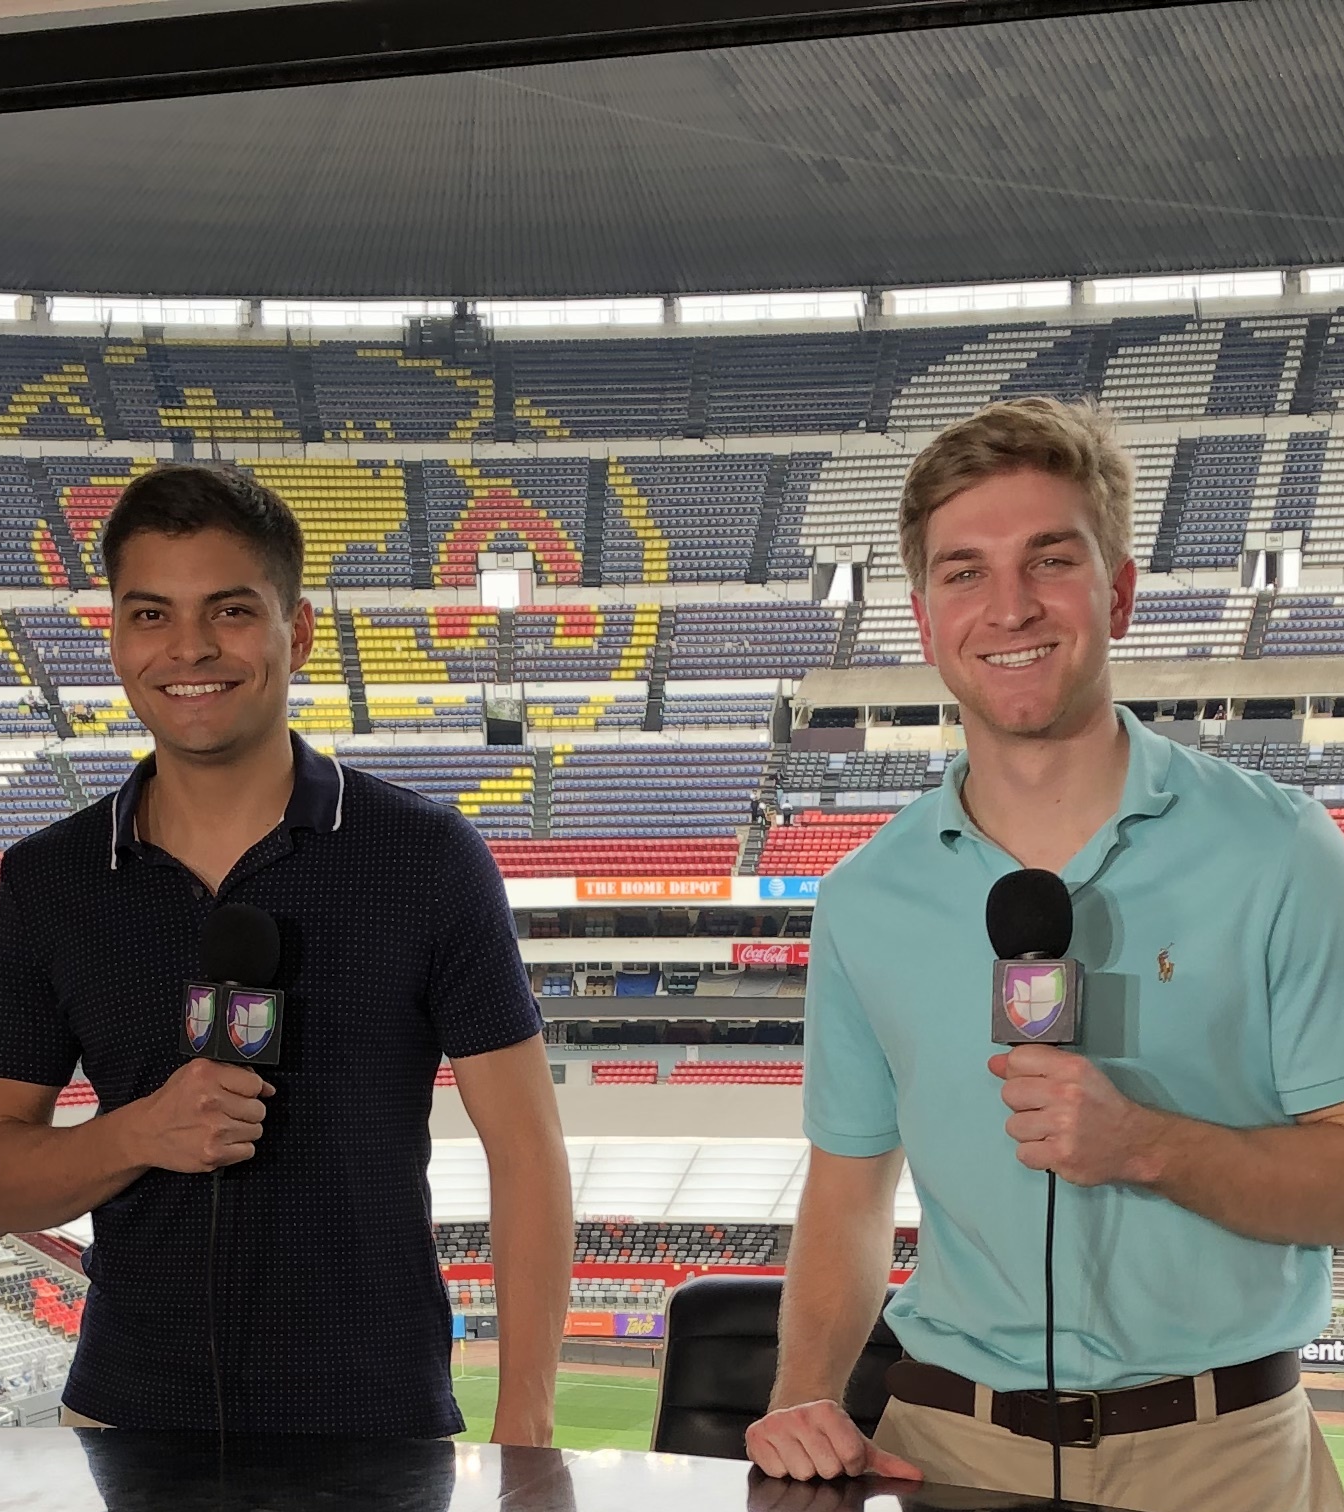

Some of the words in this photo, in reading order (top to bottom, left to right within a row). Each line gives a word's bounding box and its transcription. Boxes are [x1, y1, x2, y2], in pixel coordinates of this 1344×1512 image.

[585, 881, 616, 895] THE
[621, 881, 664, 895] HOME
[670, 881, 721, 895] DEPOT
